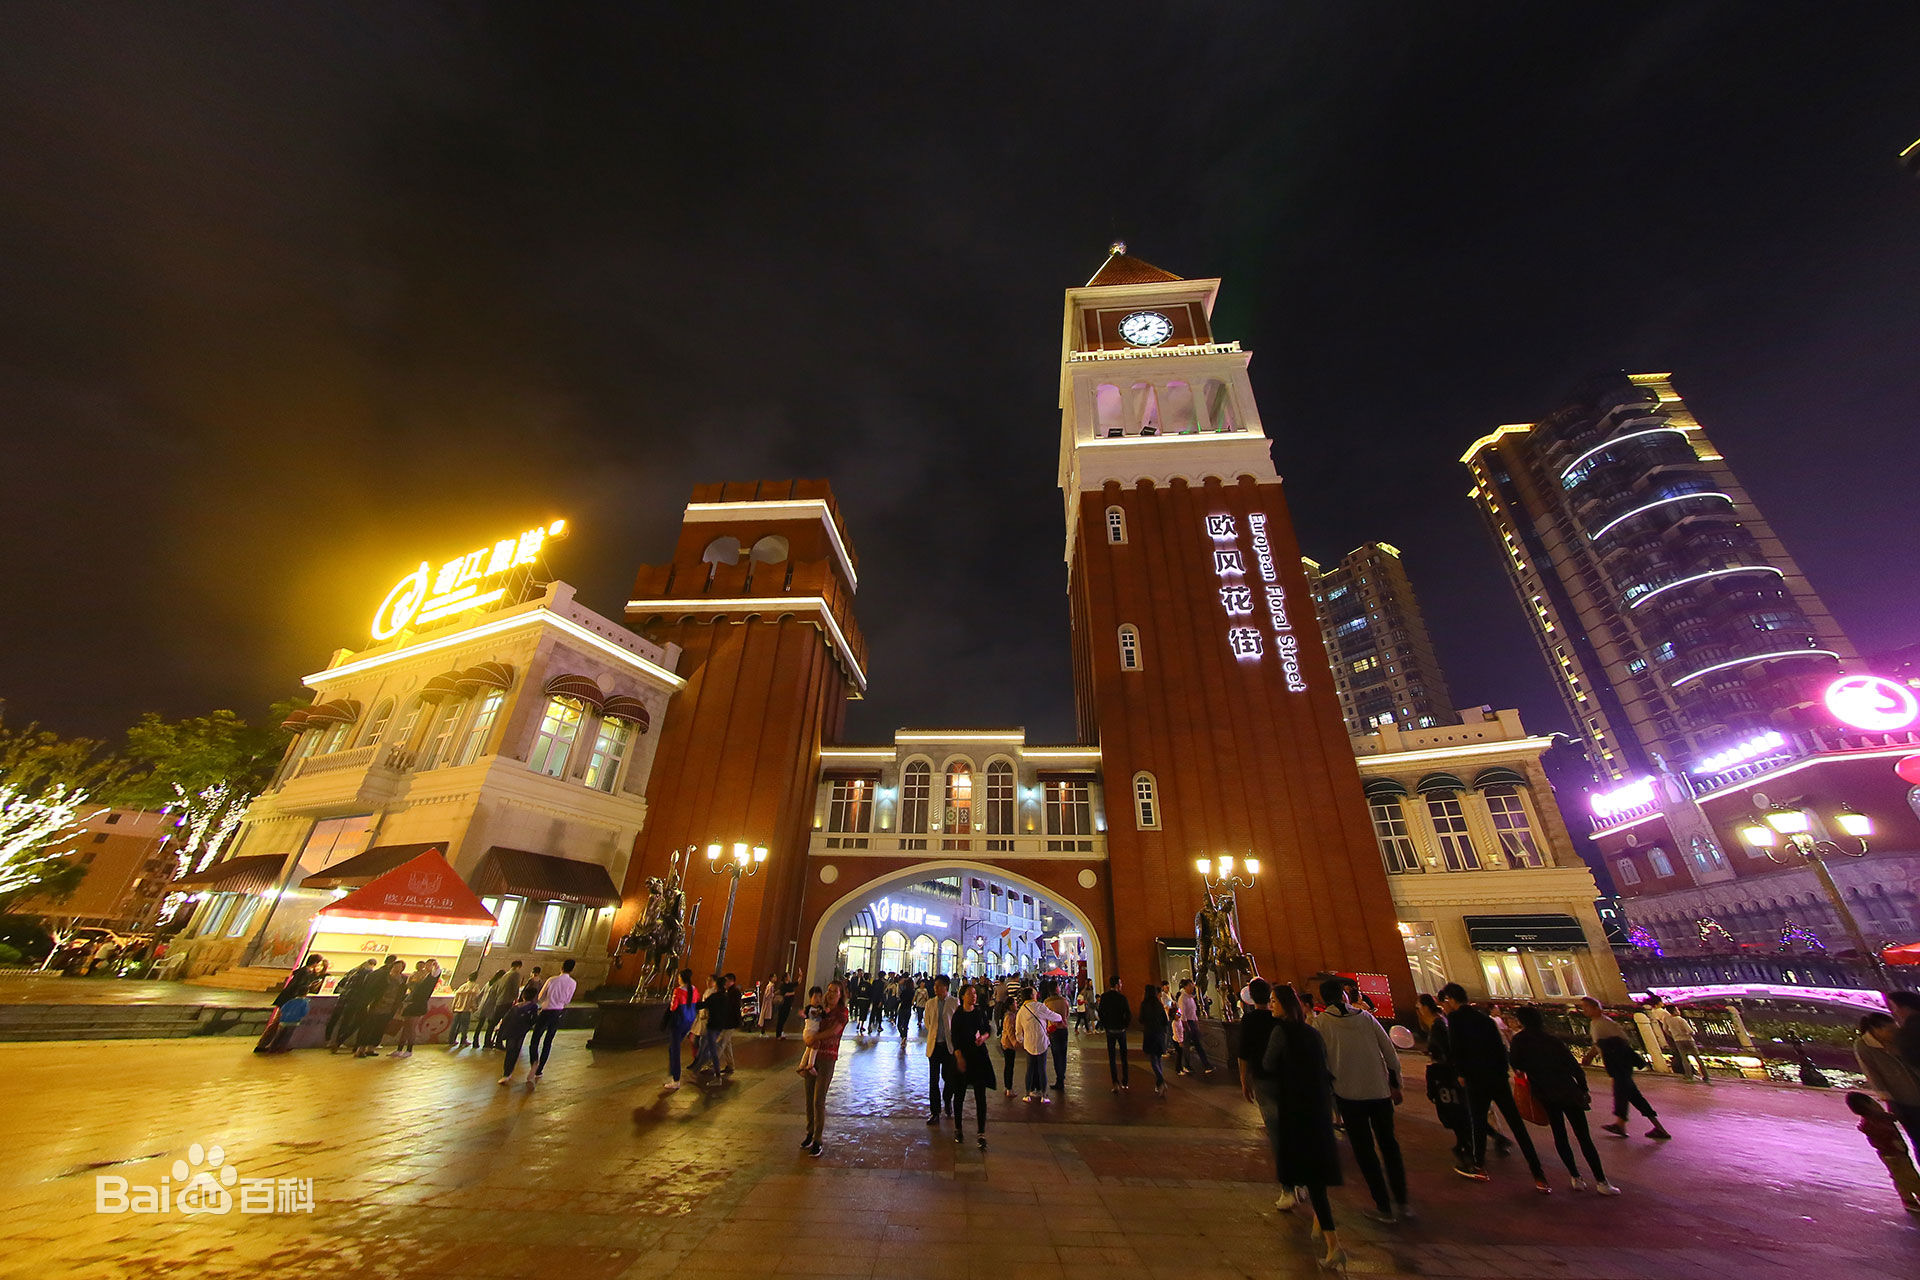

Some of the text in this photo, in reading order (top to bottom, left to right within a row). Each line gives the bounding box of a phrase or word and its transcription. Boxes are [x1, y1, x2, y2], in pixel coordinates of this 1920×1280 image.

[1207, 514, 1264, 656] 欧风花街
[1249, 513, 1306, 691] European Floral Street
